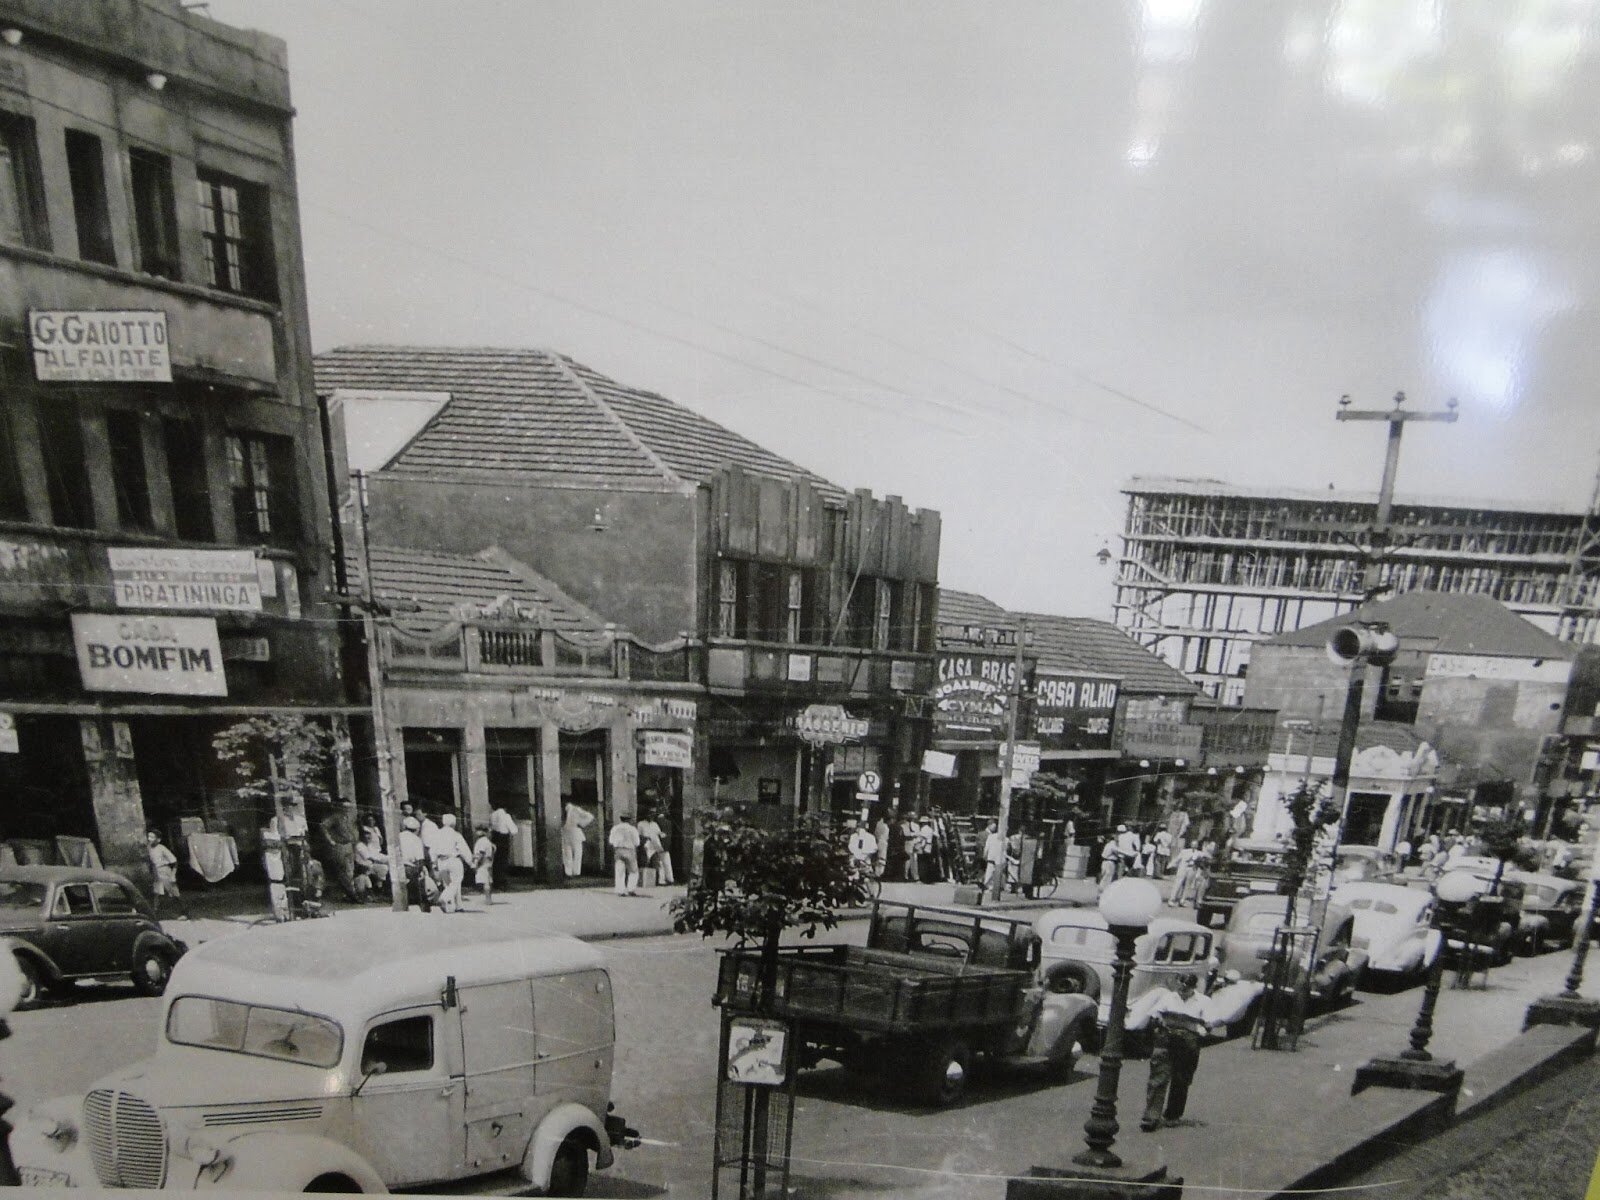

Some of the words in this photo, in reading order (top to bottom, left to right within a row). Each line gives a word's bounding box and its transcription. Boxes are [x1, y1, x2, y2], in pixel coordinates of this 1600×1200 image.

[43, 349, 162, 368] ALFAIATE
[118, 622, 178, 643] CASA
[87, 643, 213, 673] BOMFIM
[938, 658, 972, 682] CASA
[1037, 680, 1076, 708] CASA
[1080, 682, 1117, 708] ALHO
